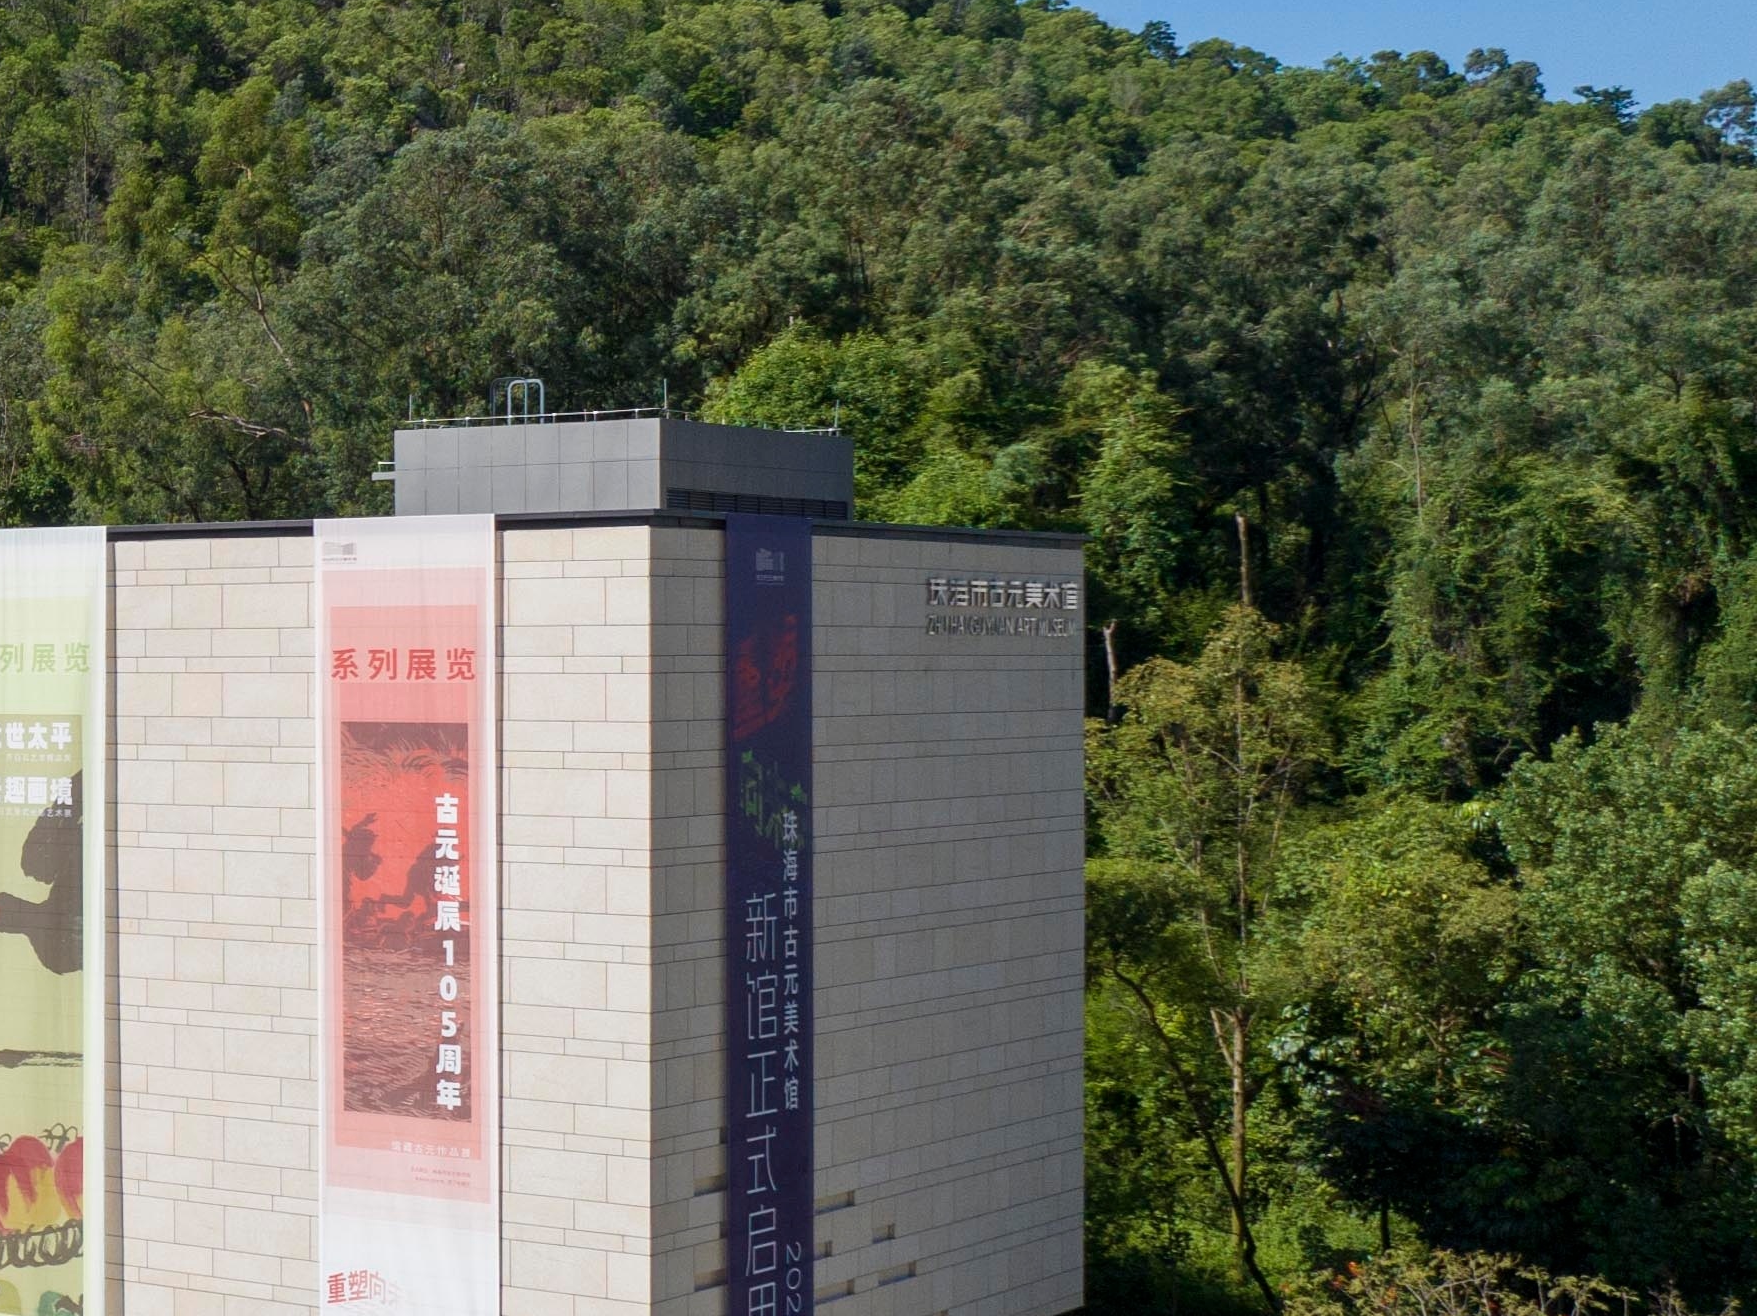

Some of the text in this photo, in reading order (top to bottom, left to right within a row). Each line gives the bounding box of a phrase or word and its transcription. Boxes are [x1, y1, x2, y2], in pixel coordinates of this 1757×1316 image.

[331, 647, 476, 681] 系列展览
[434, 793, 463, 1111] 古元诞辰105周年
[782, 809, 801, 1111] 珠海市古元美术馆
